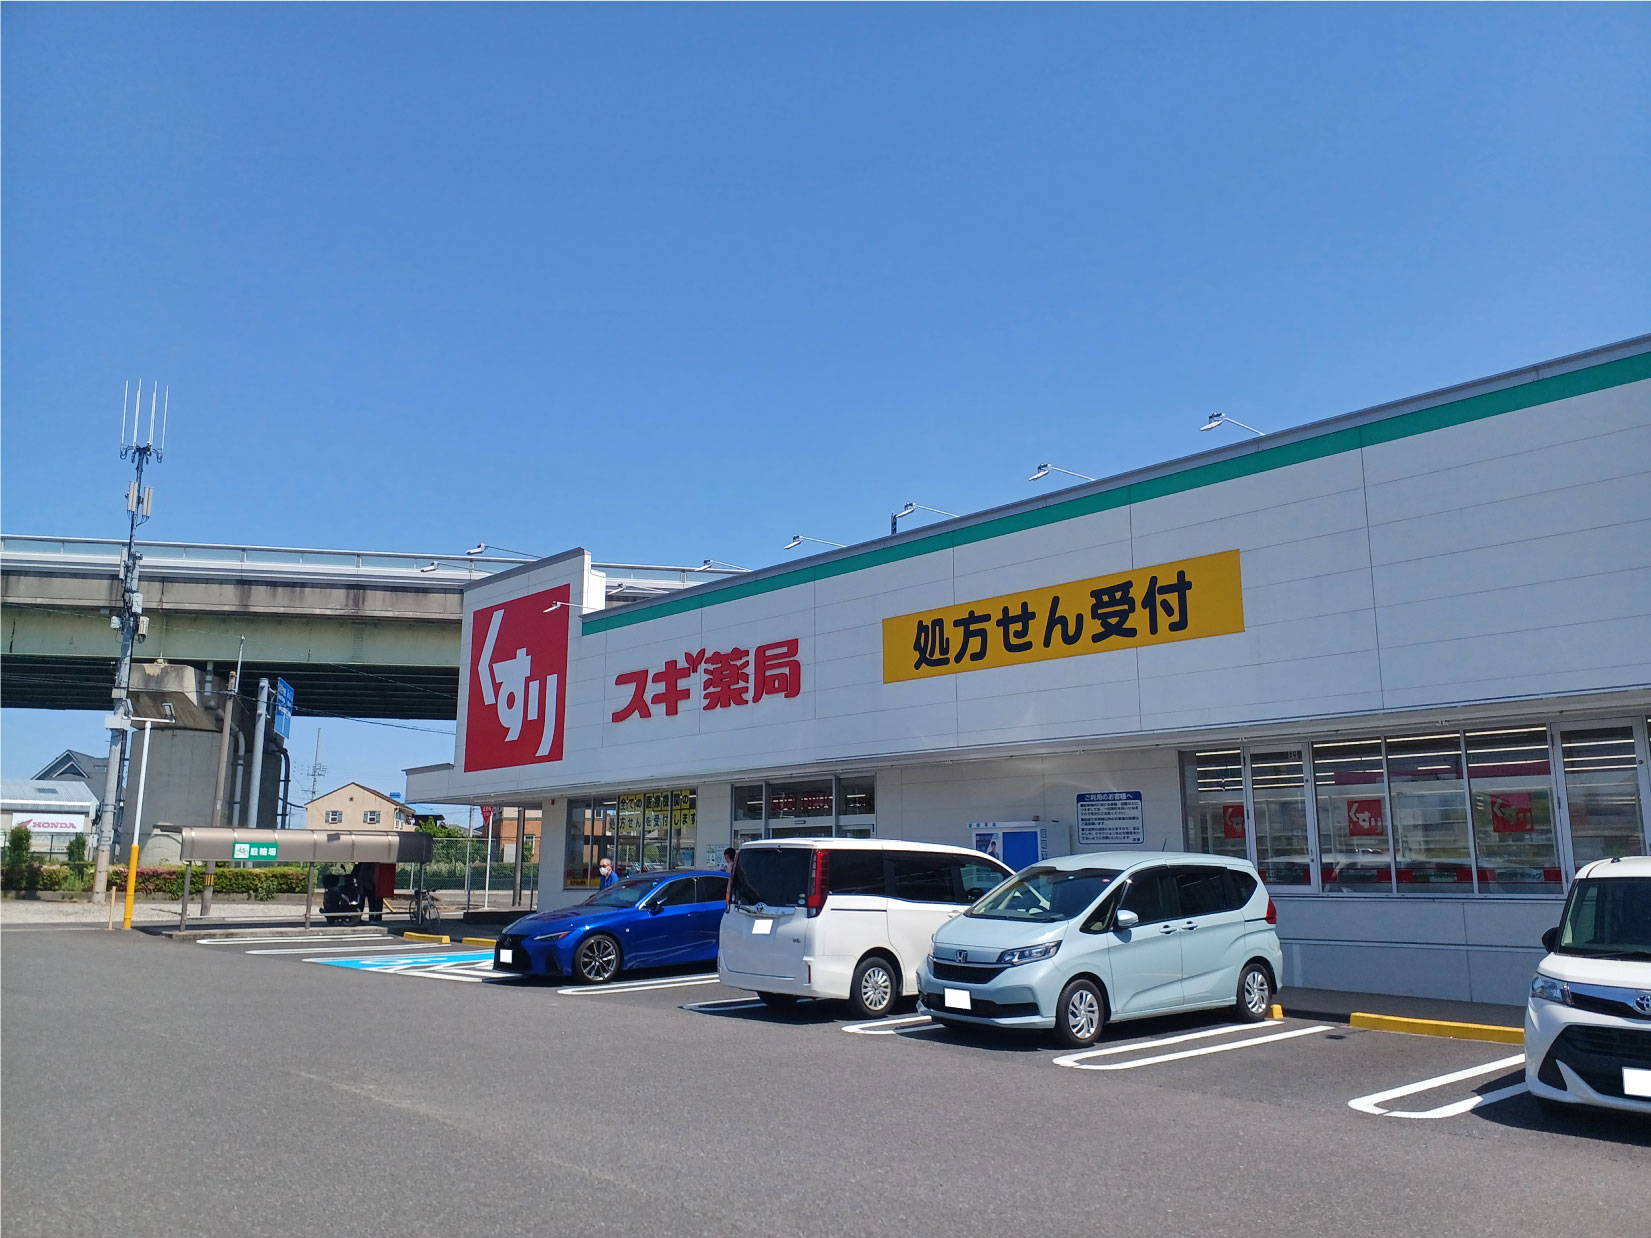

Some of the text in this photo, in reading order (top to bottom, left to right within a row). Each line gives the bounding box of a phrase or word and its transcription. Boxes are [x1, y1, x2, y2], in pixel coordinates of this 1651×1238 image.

[913, 570, 1193, 671] 処方せん受付
[477, 609, 558, 757] くすり
[611, 638, 801, 723] スギ薬局
[620, 793, 689, 810] 全ての医療機関の
[1493, 798, 1532, 829] くすり
[32, 821, 77, 829] HONDA
[1225, 807, 1246, 833] くす
[1350, 802, 1382, 833] くすり
